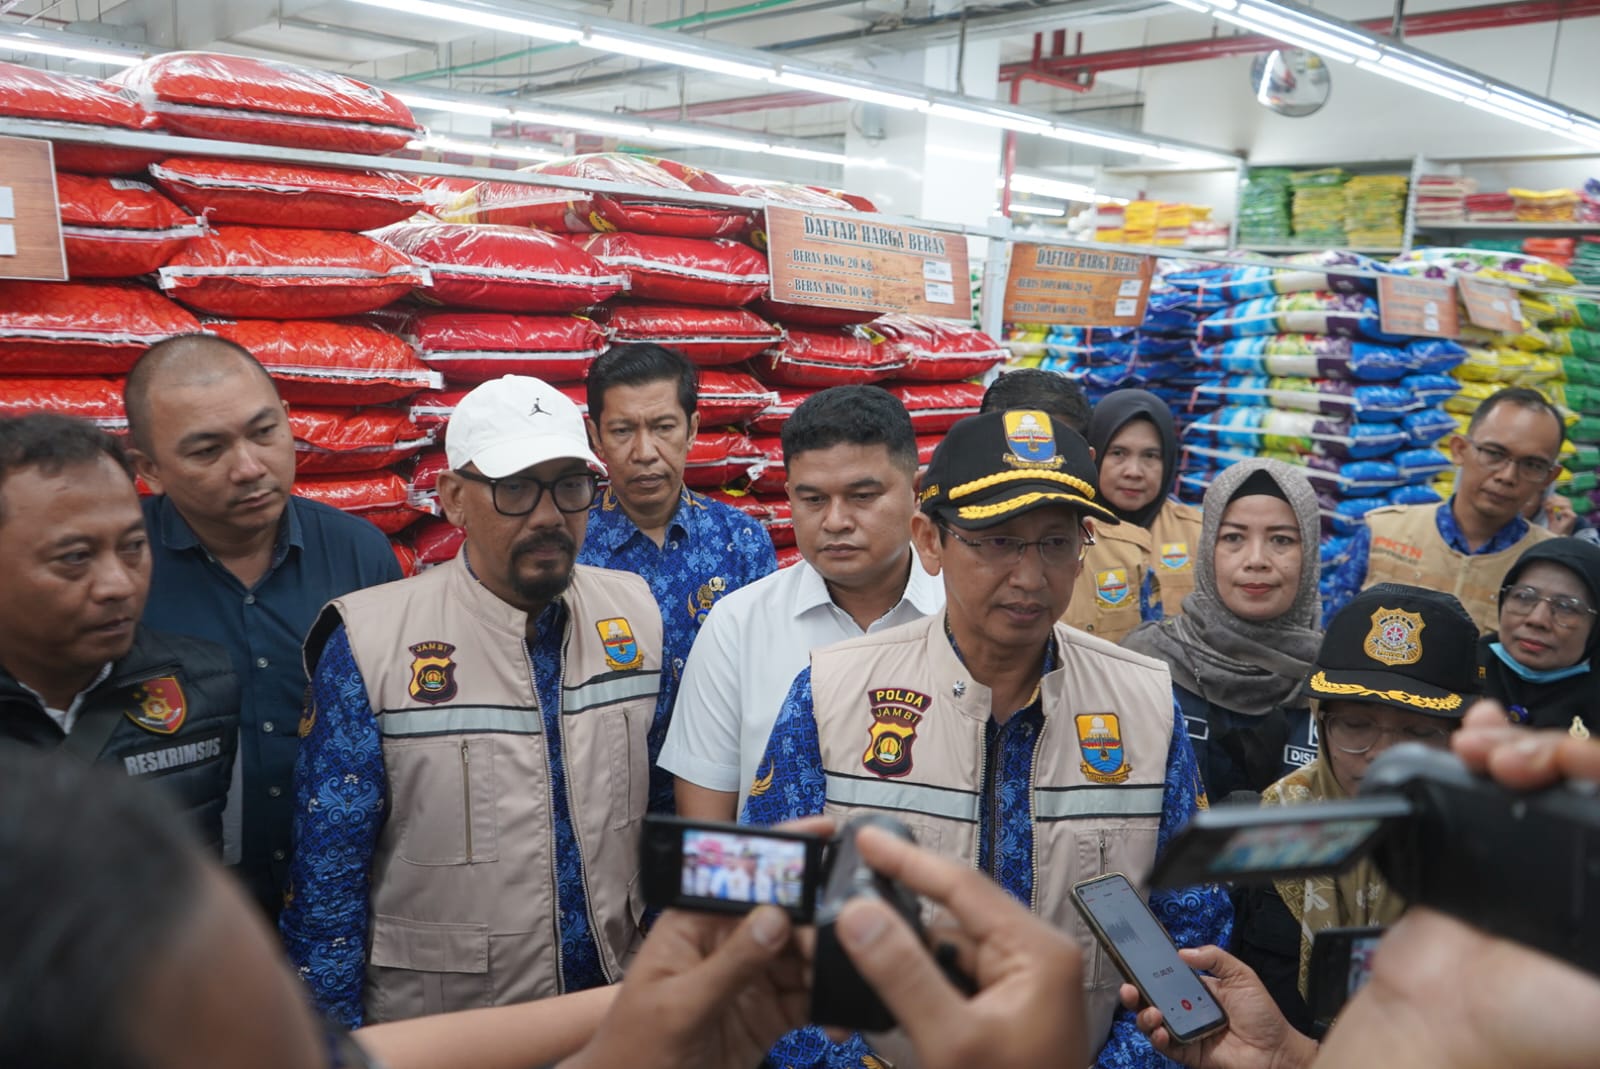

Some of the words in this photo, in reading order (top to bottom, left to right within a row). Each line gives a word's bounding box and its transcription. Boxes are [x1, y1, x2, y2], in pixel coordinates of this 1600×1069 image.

[804, 215, 857, 241] DAFTAR
[861, 224, 904, 249] HARGA
[908, 233, 945, 255] BERAS
[793, 249, 821, 263] BERAS
[823, 253, 845, 267] KING
[847, 257, 858, 269] 20
[1037, 248, 1075, 268] DAFTAR
[794, 279, 822, 293] BERAS
[825, 282, 846, 296] KING
[848, 286, 859, 297] 10
[416, 642, 448, 653] JAMBI
[876, 689, 924, 708] POLDA
[876, 706, 919, 724] JAMBI
[123, 737, 221, 776] RESKRIMSUS
